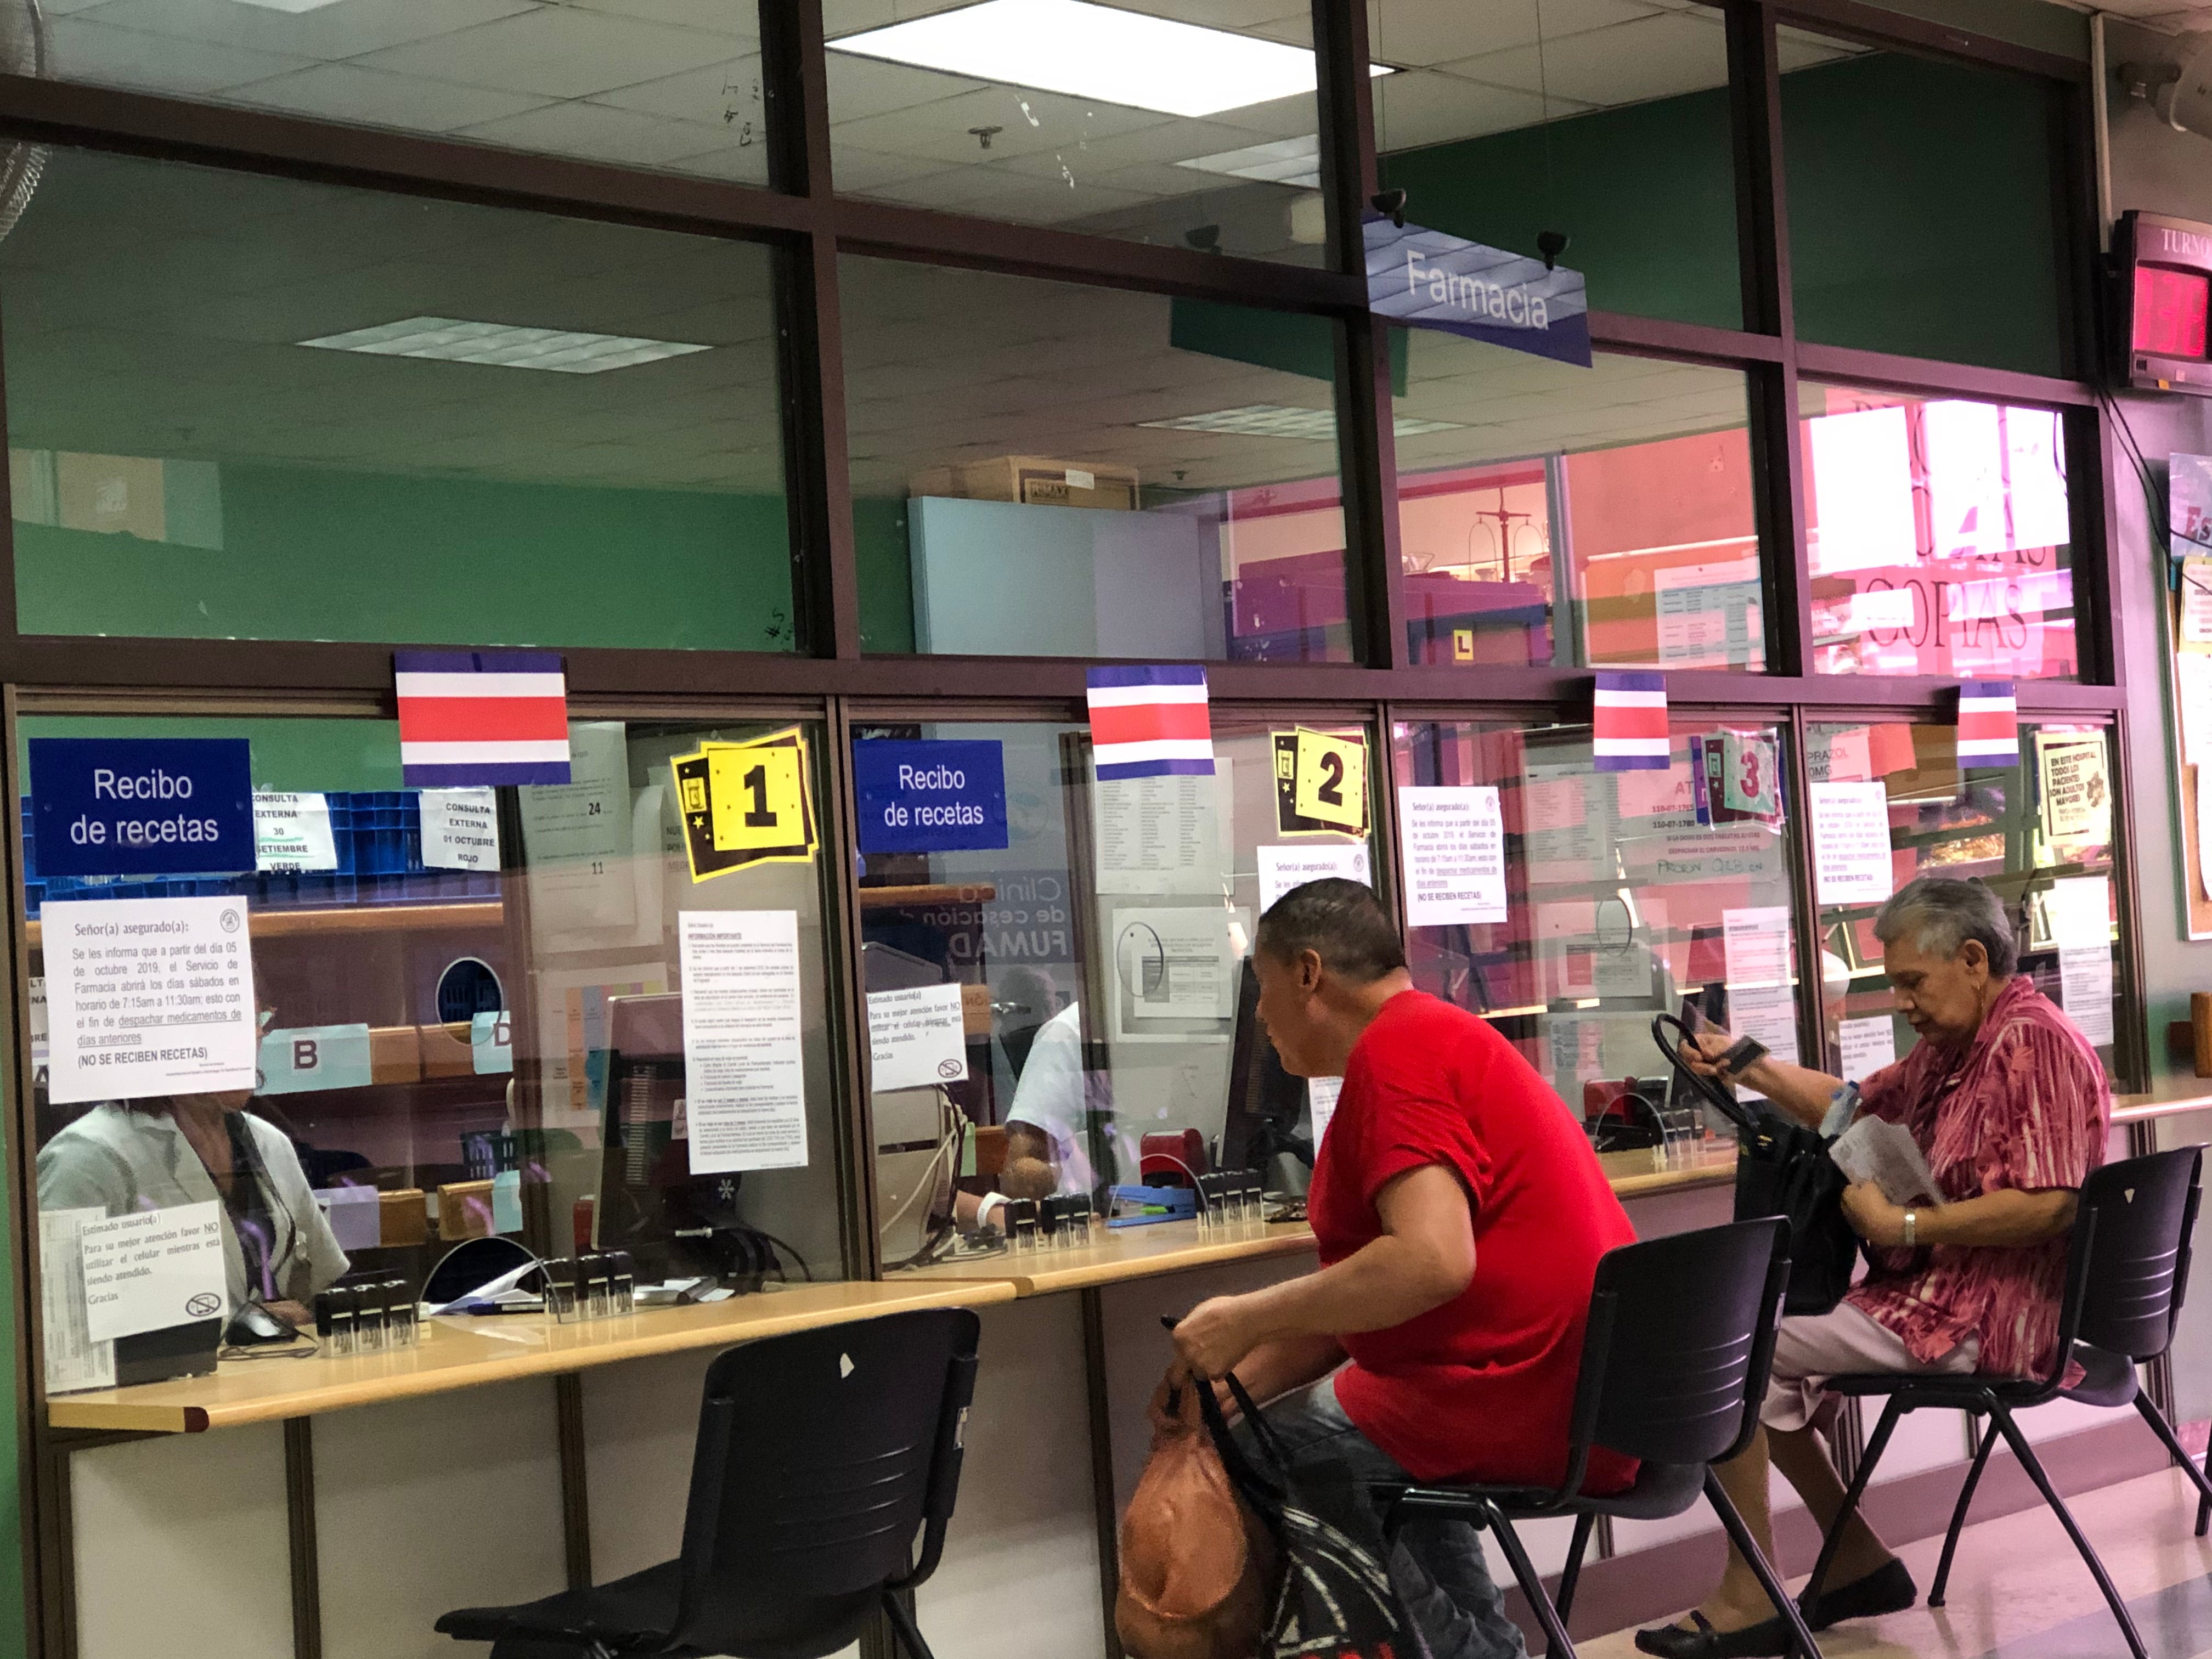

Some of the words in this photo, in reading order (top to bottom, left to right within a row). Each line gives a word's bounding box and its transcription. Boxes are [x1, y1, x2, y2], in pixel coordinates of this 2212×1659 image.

[2162, 229, 2210, 257] TURNO
[1407, 250, 1549, 330] Farmacia
[1866, 578, 2027, 650] COPIAS
[1457, 636, 1470, 653] L
[2051, 758, 2059, 766] EN
[2061, 755, 2072, 765] ESTE
[899, 765, 965, 789] Recibo
[1318, 751, 1344, 806] 2
[1740, 751, 1759, 798] 3
[2051, 766, 2069, 776] TODOS
[94, 769, 192, 799] Recibo
[743, 764, 777, 827] 1
[446, 803, 490, 814] CONSULTA
[589, 802, 601, 815] 24
[884, 803, 909, 826] de
[915, 802, 984, 825] recetas
[1413, 802, 1434, 811] Señor(a)
[70, 815, 105, 844] de
[117, 815, 219, 844] recetas
[449, 819, 487, 829] EXTERNA
[455, 837, 495, 847] OCTUBRE
[458, 854, 478, 863] ROJO
[592, 861, 603, 874] 11
[1276, 862, 1300, 872] Señor(a)
[1436, 892, 1457, 900] RECIBEN
[75, 923, 119, 936] Señor(a)
[123, 921, 189, 935] asegurado(a):
[72, 948, 84, 960] Se
[88, 948, 101, 959] les
[105, 947, 138, 958] informa
[142, 947, 157, 958] que
[161, 947, 166, 956] a
[170, 945, 190, 958] partir
[194, 944, 206, 954] del
[210, 943, 223, 953] día
[226, 942, 236, 953] 05
[74, 966, 84, 977] de
[95, 964, 127, 975] octubre
[170, 962, 177, 972] el
[186, 960, 218, 971] Servicio
[228, 960, 238, 969] de
[75, 983, 116, 994] Farmacia
[150, 980, 162, 990] los
[167, 979, 184, 989] días
[189, 977, 224, 988] sábados
[229, 977, 239, 986] en
[76, 1000, 106, 1012] horario
[109, 999, 120, 1009] de
[206, 994, 223, 1004] esto
[225, 994, 240, 1002] con
[869, 995, 893, 1004] Estimado
[894, 991, 921, 1001] usuario(a)
[77, 1017, 84, 1028] el
[89, 1017, 99, 1028] fin
[104, 1017, 114, 1026] de
[119, 1014, 163, 1028] despachar
[167, 1011, 227, 1023] medicamentos
[231, 1009, 241, 1020] de
[870, 1012, 881, 1020] Para
[893, 1009, 907, 1017] mejor
[950, 1002, 960, 1010] NO
[77, 1035, 96, 1046] días
[99, 1033, 142, 1045] anteriores
[78, 1054, 96, 1069] (NO
[99, 1054, 111, 1065] SE
[115, 1051, 157, 1064] RECIBEN
[161, 1047, 207, 1062] RECETAS)
[294, 1040, 318, 1069] B
[873, 1052, 893, 1060] Gracias
[83, 1222, 119, 1235] Estimado
[122, 1214, 160, 1228] usuario(a)
[84, 1243, 102, 1254] Para
[105, 1242, 114, 1250] su
[118, 1238, 141, 1249] mejor
[144, 1230, 177, 1243] atención
[181, 1227, 200, 1238] favor
[204, 1222, 218, 1233] NO
[86, 1257, 114, 1270] utilizar
[120, 1254, 127, 1264] el
[134, 1250, 160, 1262] celular
[167, 1243, 200, 1255] mientras
[87, 1274, 112, 1286] siendo
[115, 1267, 152, 1281] atendido.
[88, 1293, 119, 1305] Gracias
